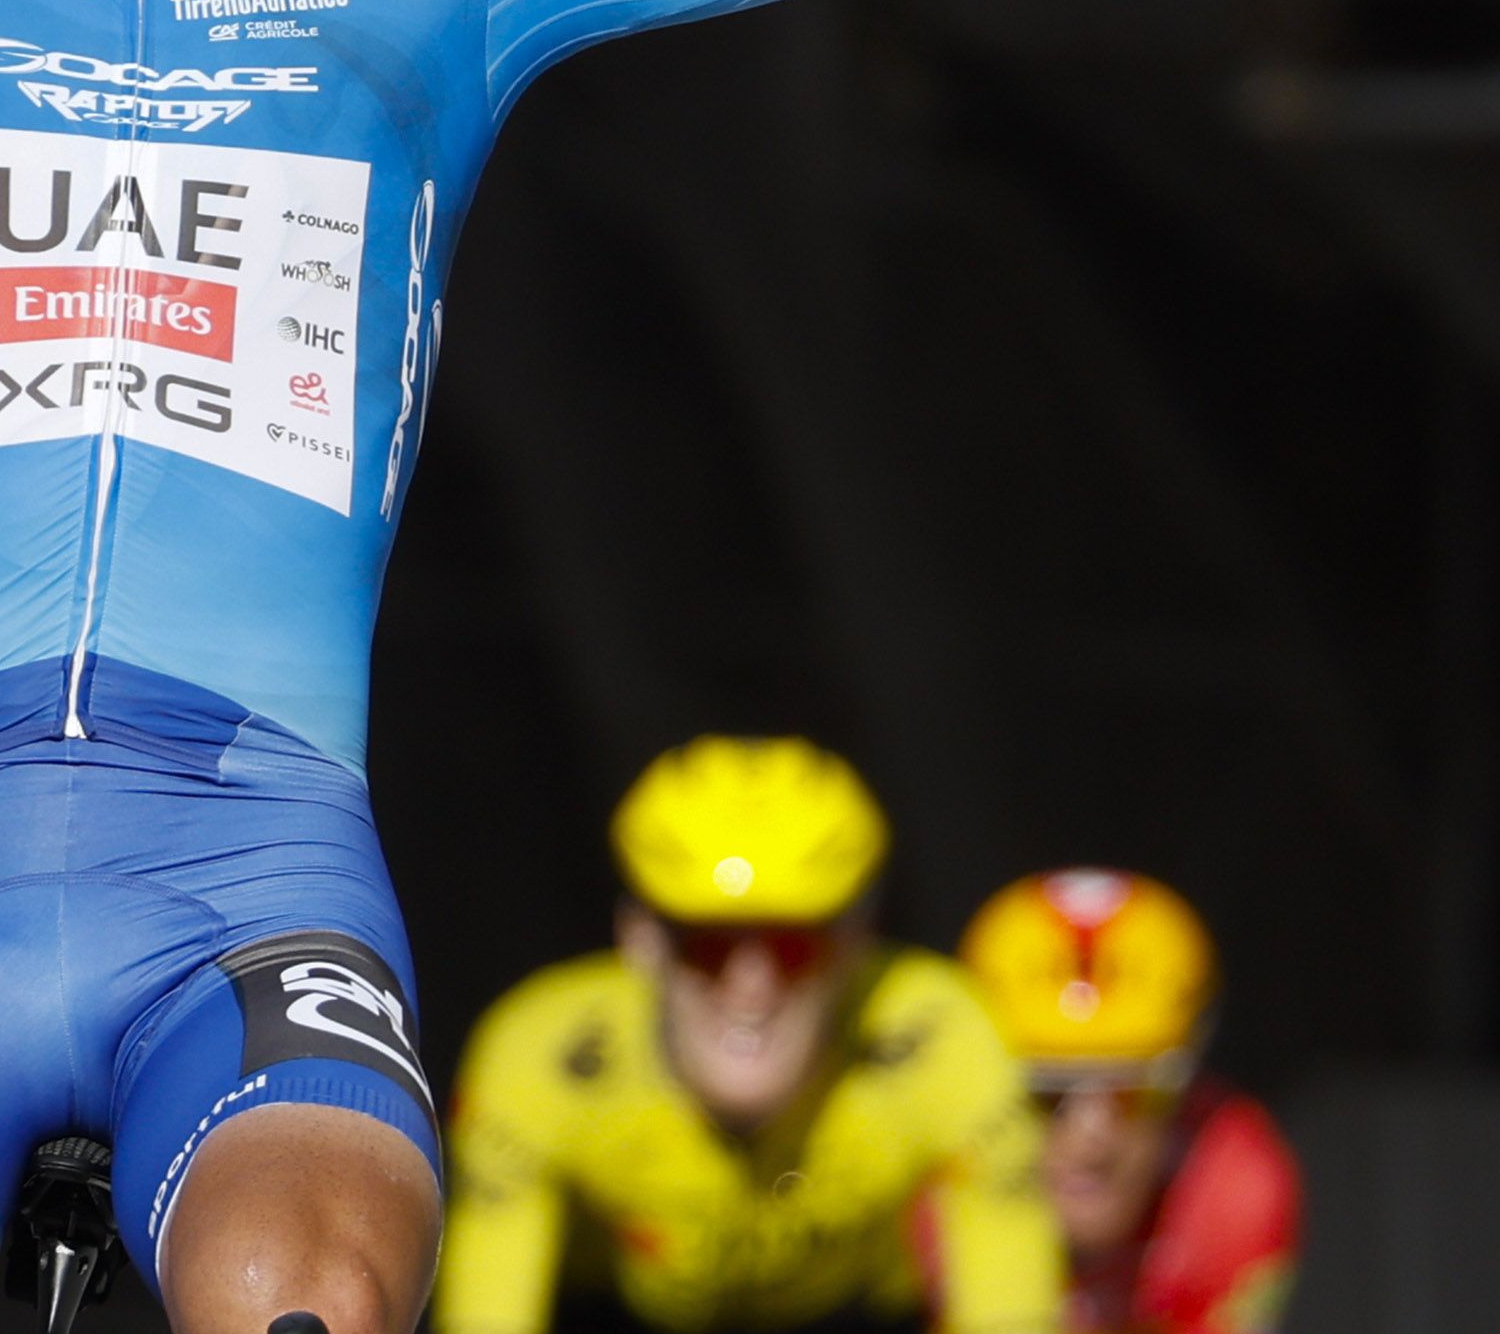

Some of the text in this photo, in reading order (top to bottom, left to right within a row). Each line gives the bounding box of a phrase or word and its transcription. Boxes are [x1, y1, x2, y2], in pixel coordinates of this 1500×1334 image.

[246, 26, 320, 40] AGRICOLE
[297, 213, 360, 236] COLNAGO
[14, 283, 213, 336] Emirates
[304, 322, 346, 355] IHC
[288, 431, 351, 463] PISSEI
